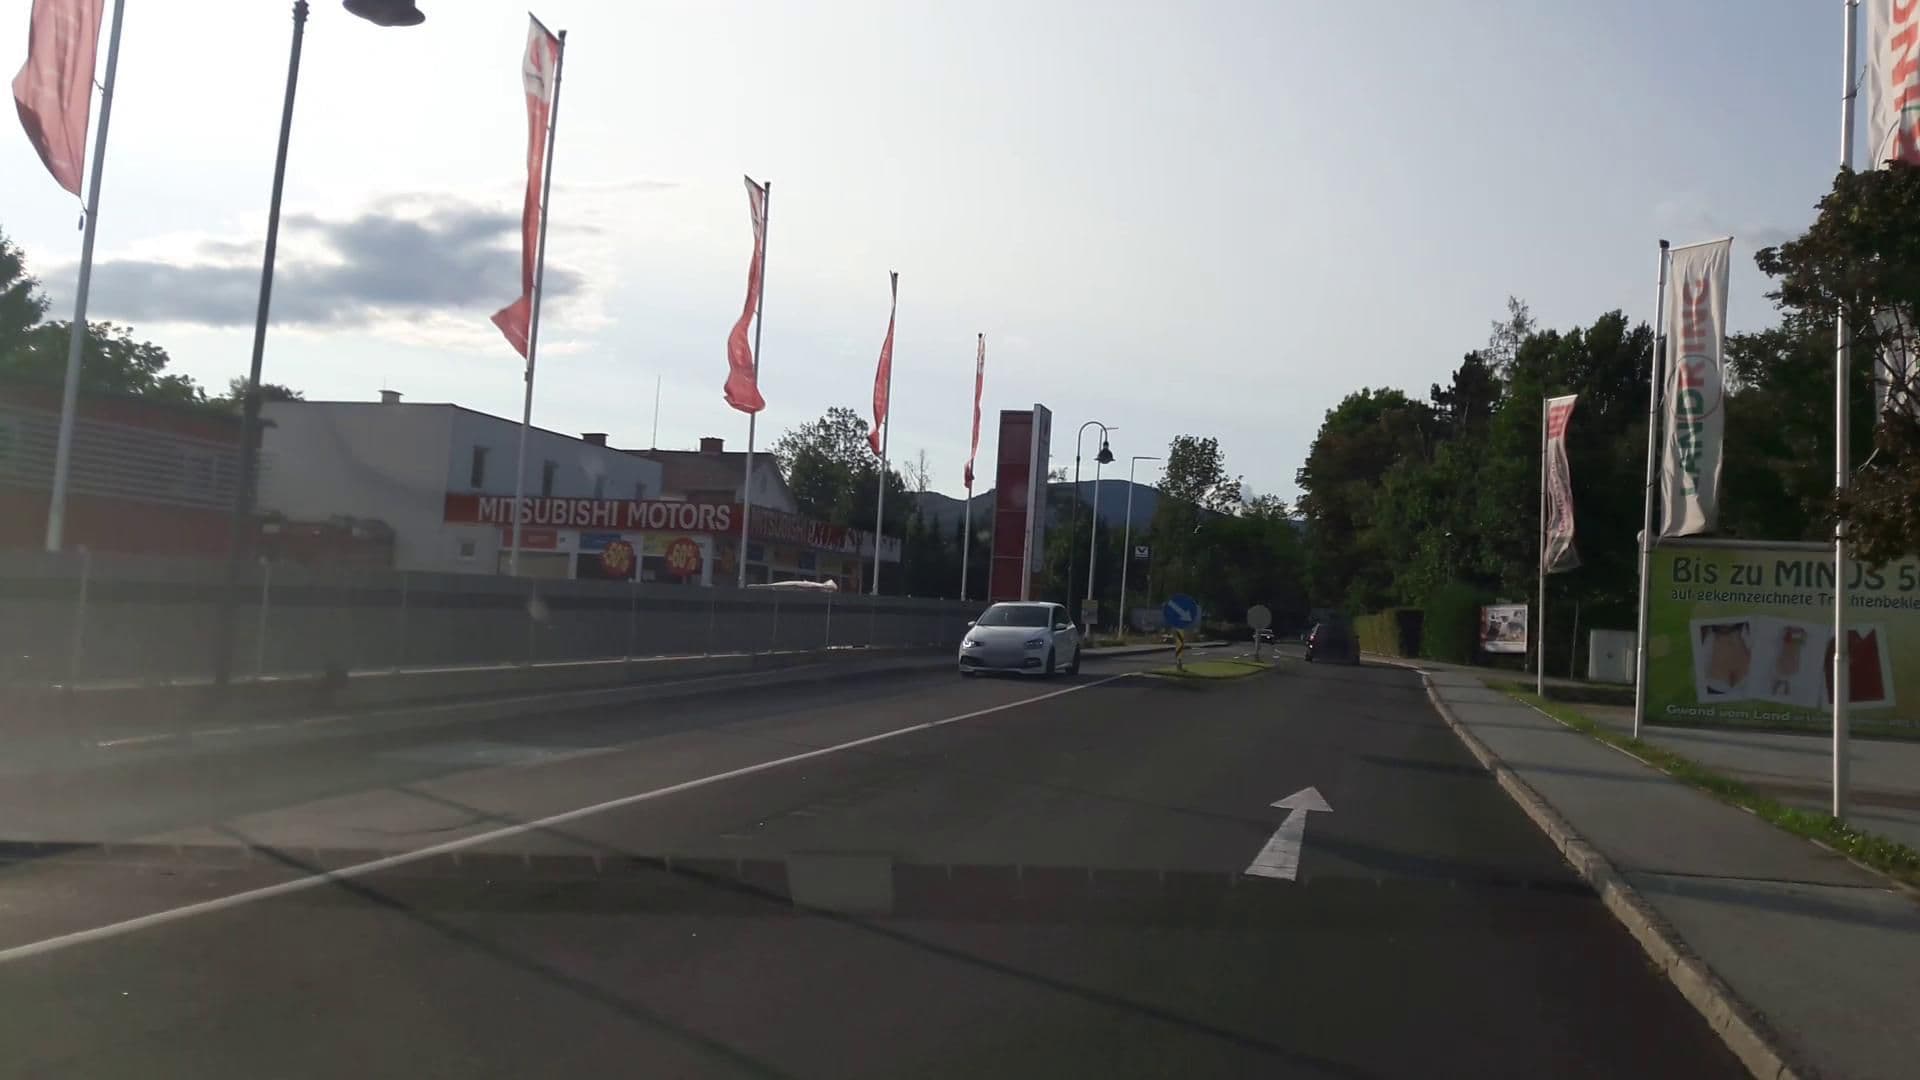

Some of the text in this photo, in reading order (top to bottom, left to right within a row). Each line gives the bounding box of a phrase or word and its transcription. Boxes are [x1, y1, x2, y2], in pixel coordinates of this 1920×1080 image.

[478, 497, 618, 527] MITSUBISHI
[627, 500, 731, 531] MOTORS
[1672, 556, 1718, 584] Bis
[1730, 563, 1763, 586] zu
[1898, 564, 1920, 591] 5
[1671, 588, 1692, 601] auf
[1697, 588, 1813, 606] gekennzeichnete
[1754, 709, 1791, 721] Land
